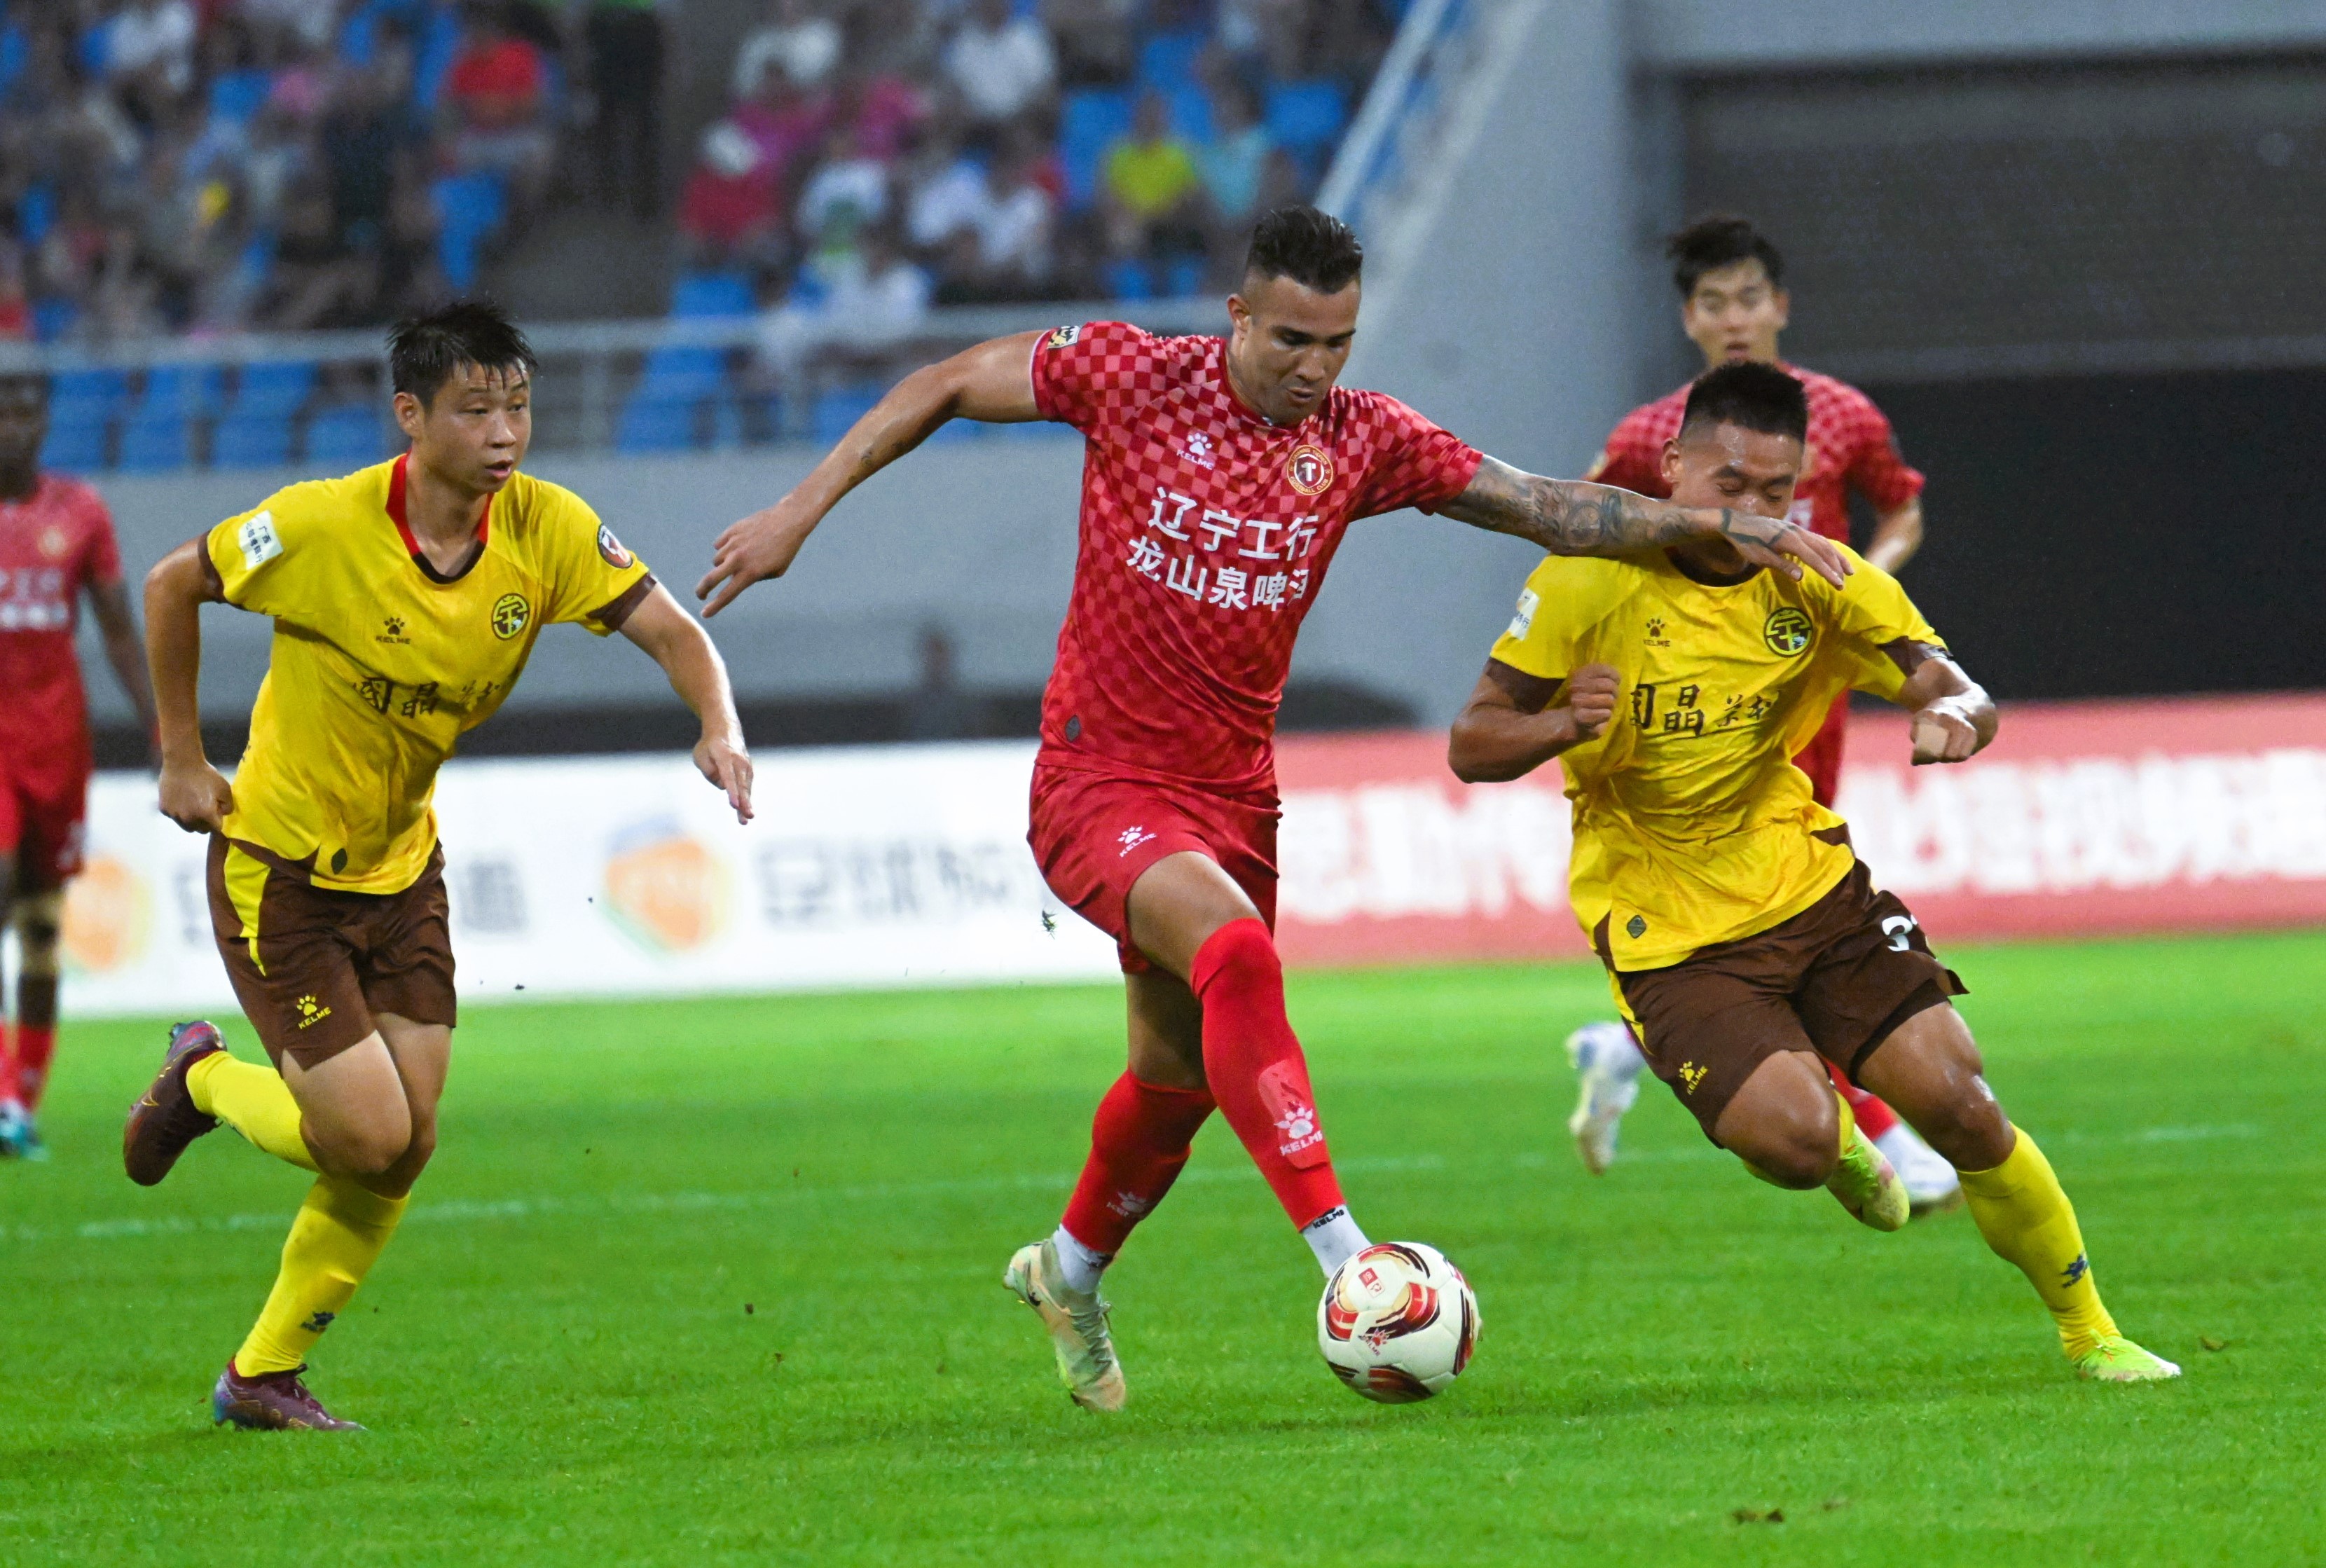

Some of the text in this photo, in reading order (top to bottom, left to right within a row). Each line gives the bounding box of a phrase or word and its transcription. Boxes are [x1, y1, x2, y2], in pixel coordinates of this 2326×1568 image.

[1176, 448, 1214, 471] KELME
[1148, 486, 1319, 561] 辽宁工行
[376, 635, 411, 645] KELME
[1119, 832, 1157, 858] KELME
[298, 1006, 332, 1030] KELME
[1686, 1065, 1708, 1095] KELME
